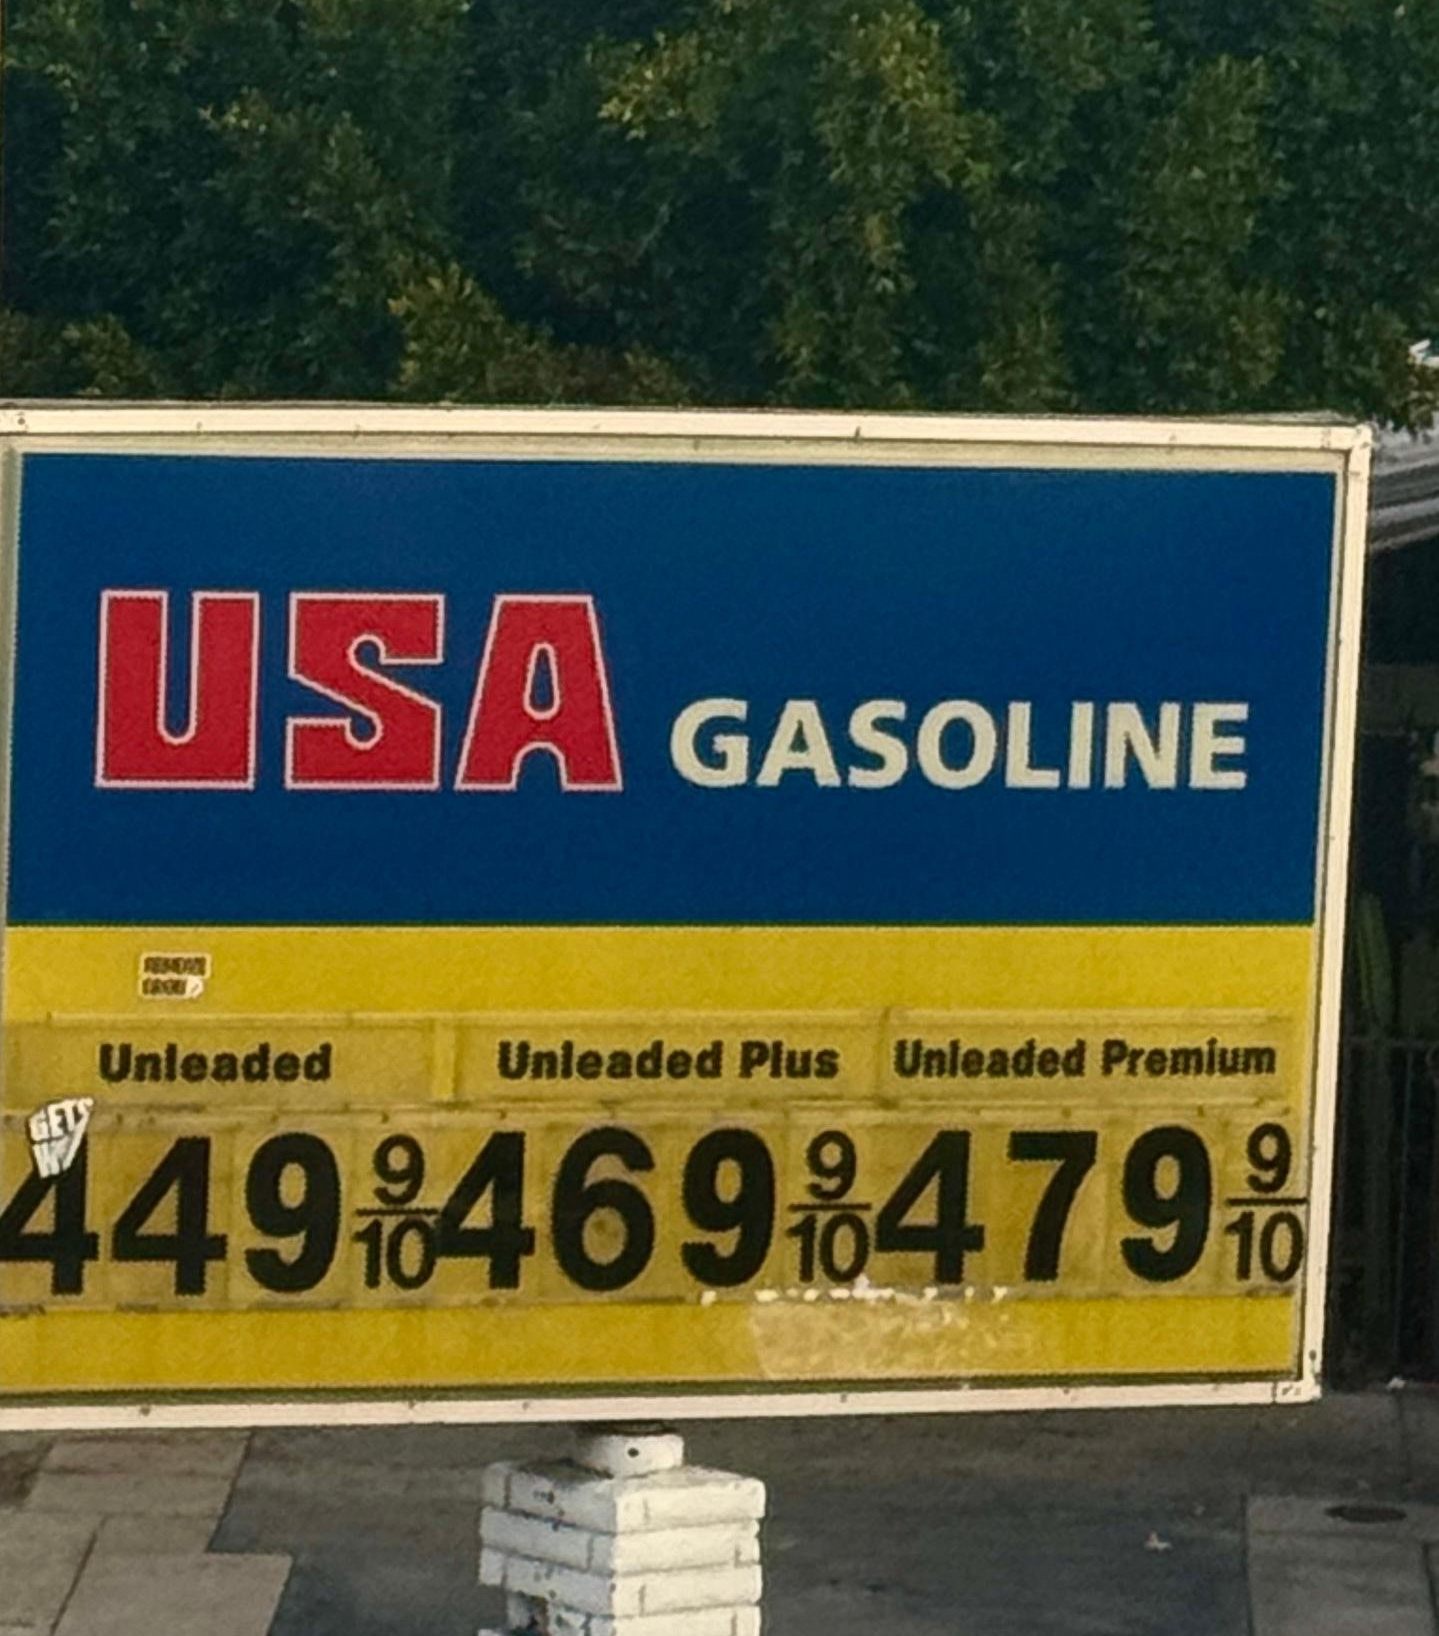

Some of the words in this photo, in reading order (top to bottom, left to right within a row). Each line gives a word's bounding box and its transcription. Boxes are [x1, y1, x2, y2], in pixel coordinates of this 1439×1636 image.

[95, 589, 624, 792] USA
[669, 699, 1250, 791] GASOLINE
[98, 1043, 332, 1083] Unleaded
[497, 1040, 721, 1080] Unleaded
[739, 1040, 840, 1078] Plus
[895, 1038, 1085, 1078] Unleaded
[1101, 1037, 1277, 1077] Premium
[373, 1135, 424, 1205] 9
[807, 1131, 857, 1200] 9
[1247, 1124, 1292, 1194] 9
[436, 1126, 776, 1291] 469
[874, 1125, 1212, 1285] 479
[353, 1218, 438, 1289] 10
[787, 1213, 871, 1283] 10
[1225, 1211, 1305, 1283] 10
